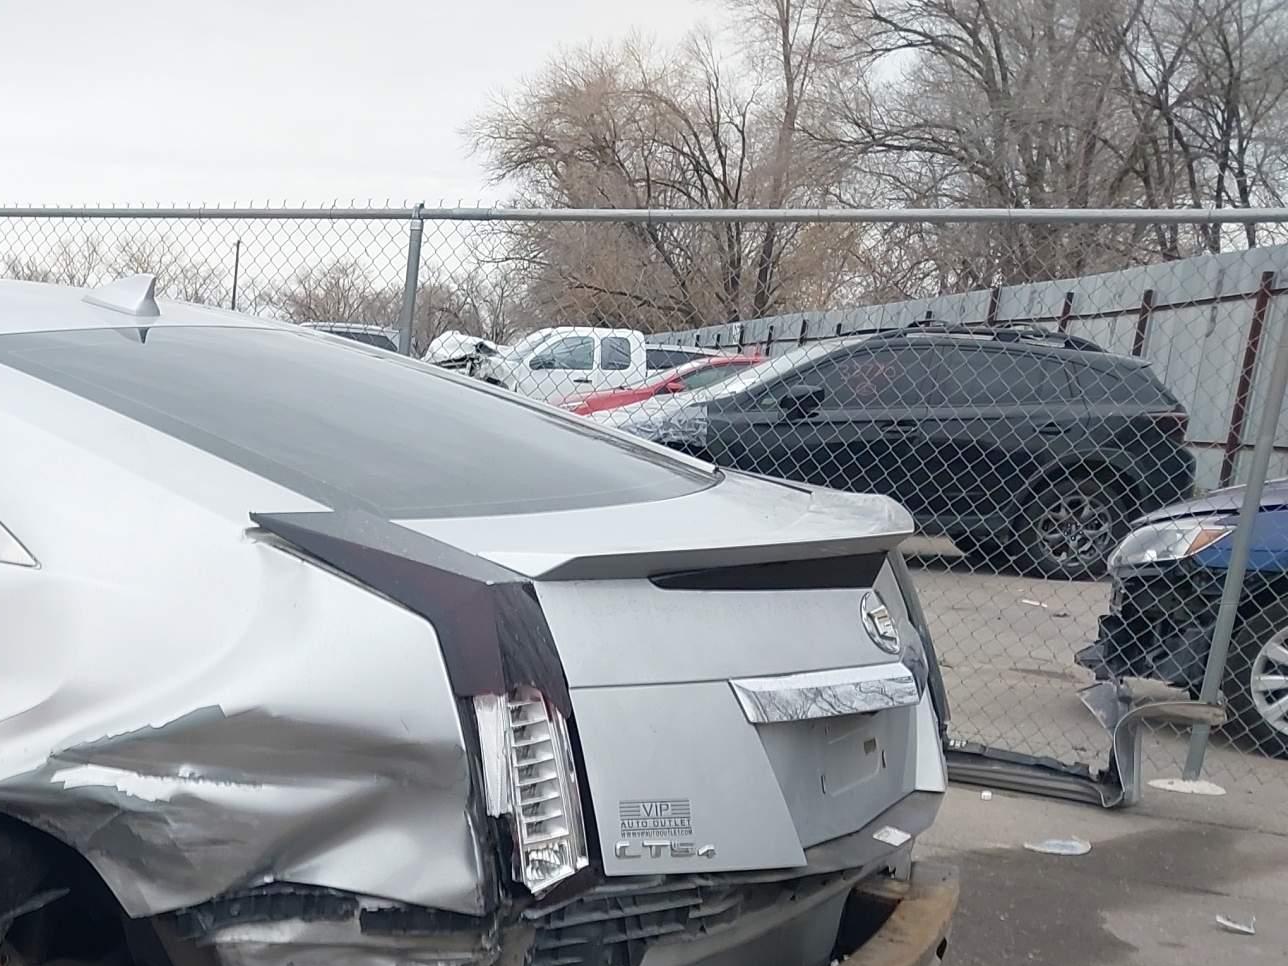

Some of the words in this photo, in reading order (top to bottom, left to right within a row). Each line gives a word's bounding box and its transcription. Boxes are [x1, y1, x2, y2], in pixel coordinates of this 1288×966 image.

[642, 802, 670, 817] VIP
[621, 820, 648, 829] AUTO
[653, 818, 691, 828] OUTLET
